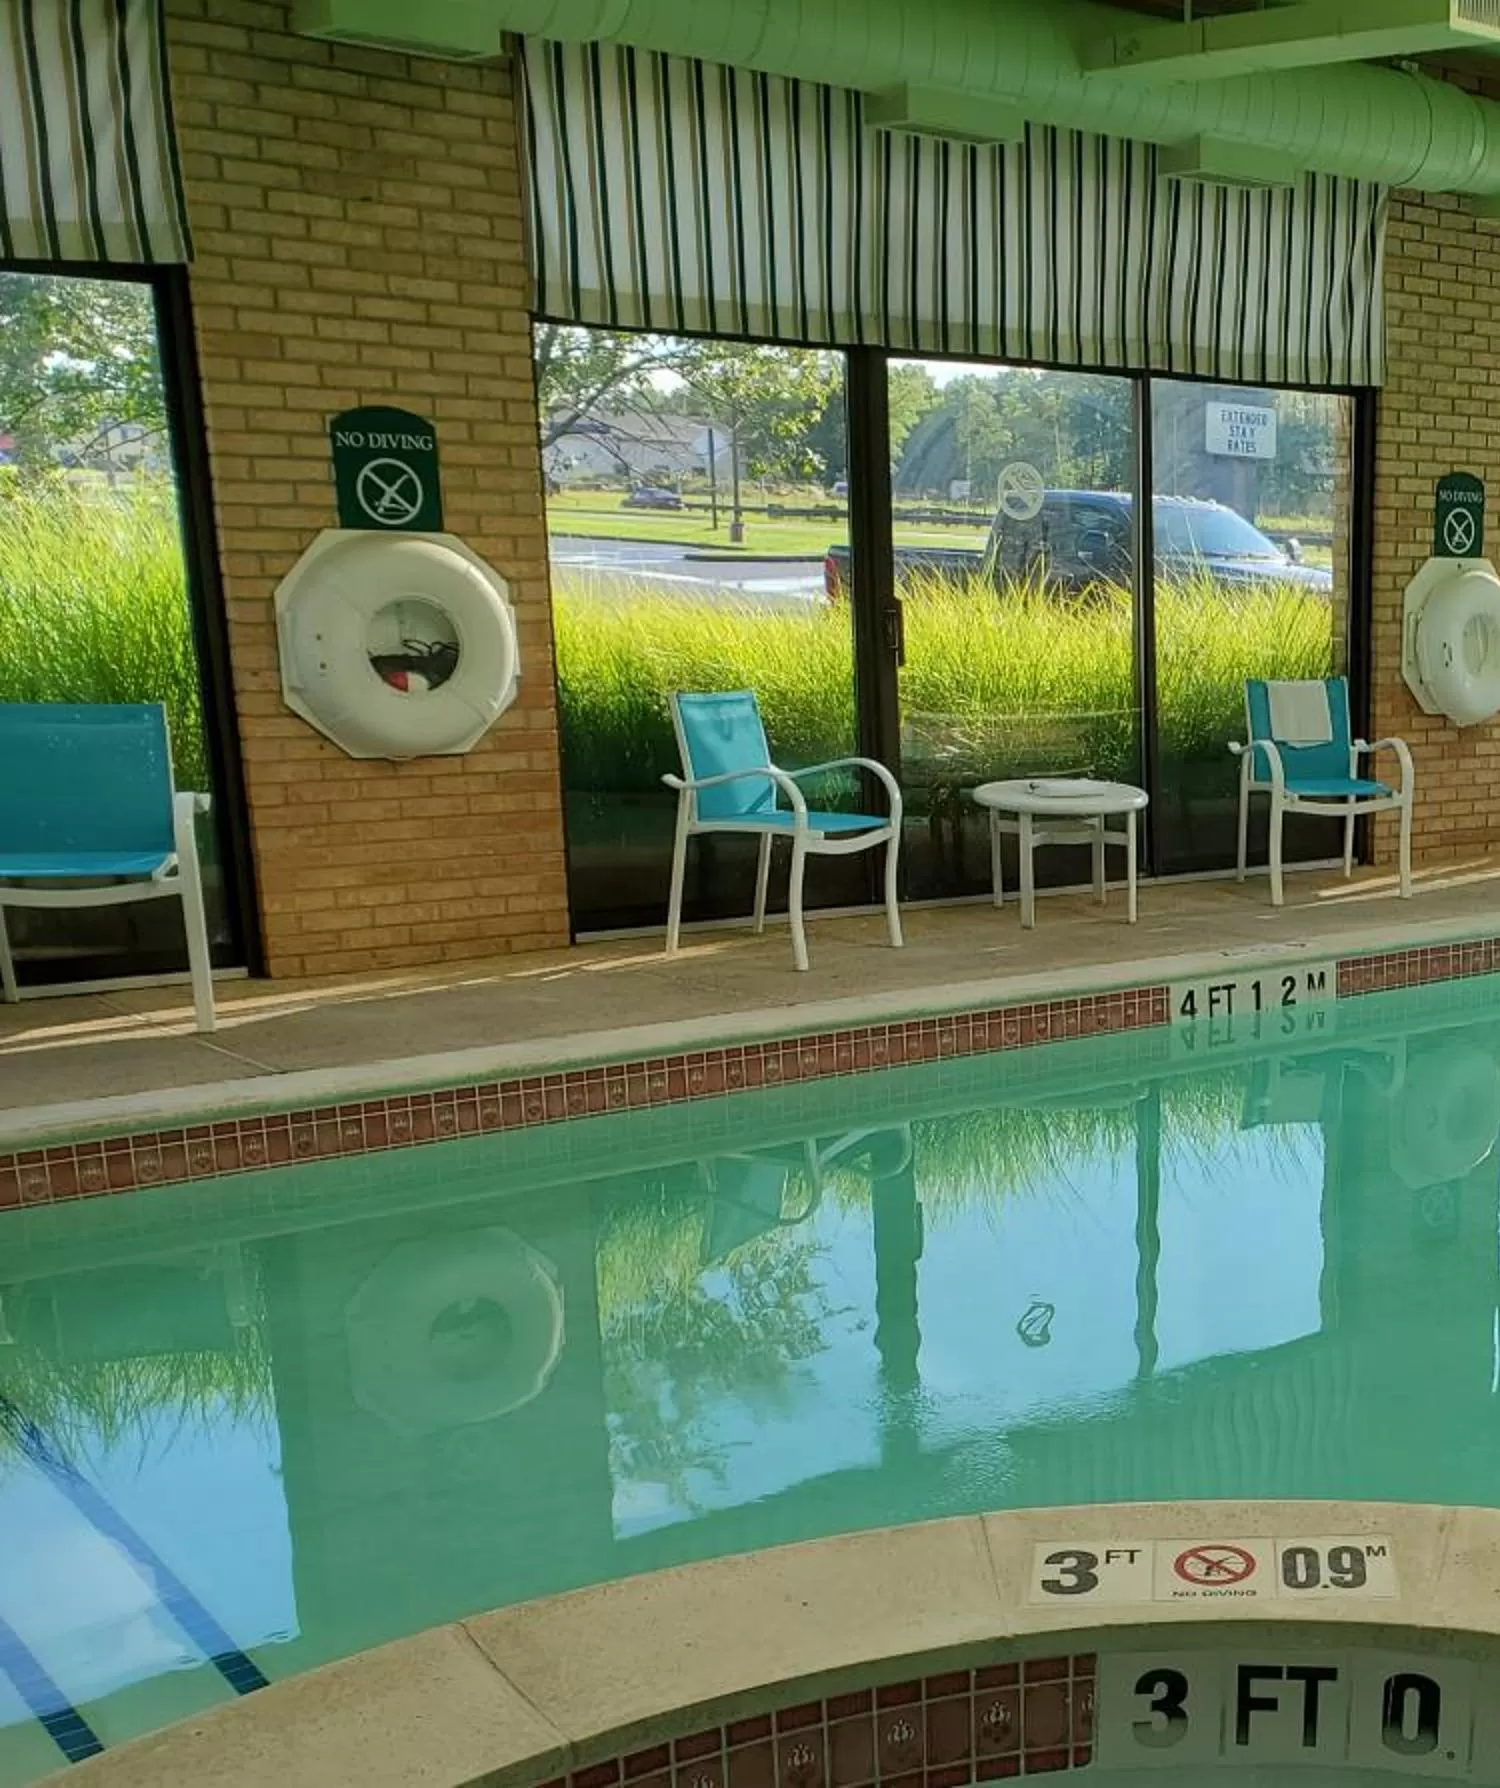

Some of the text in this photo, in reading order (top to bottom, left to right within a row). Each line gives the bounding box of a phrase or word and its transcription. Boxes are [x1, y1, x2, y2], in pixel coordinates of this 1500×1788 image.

[1220, 409, 1267, 426] EXTENDED
[1228, 425, 1255, 438] STAY
[335, 432, 433, 451] NO DIVING
[1439, 489, 1483, 504] NO DIVING
[1180, 989, 1198, 1020] 4
[1207, 983, 1237, 1018] FT
[1041, 1549, 1099, 1594] 3
[1131, 1667, 1189, 1749] 3
[1235, 1664, 1338, 1747] FT
